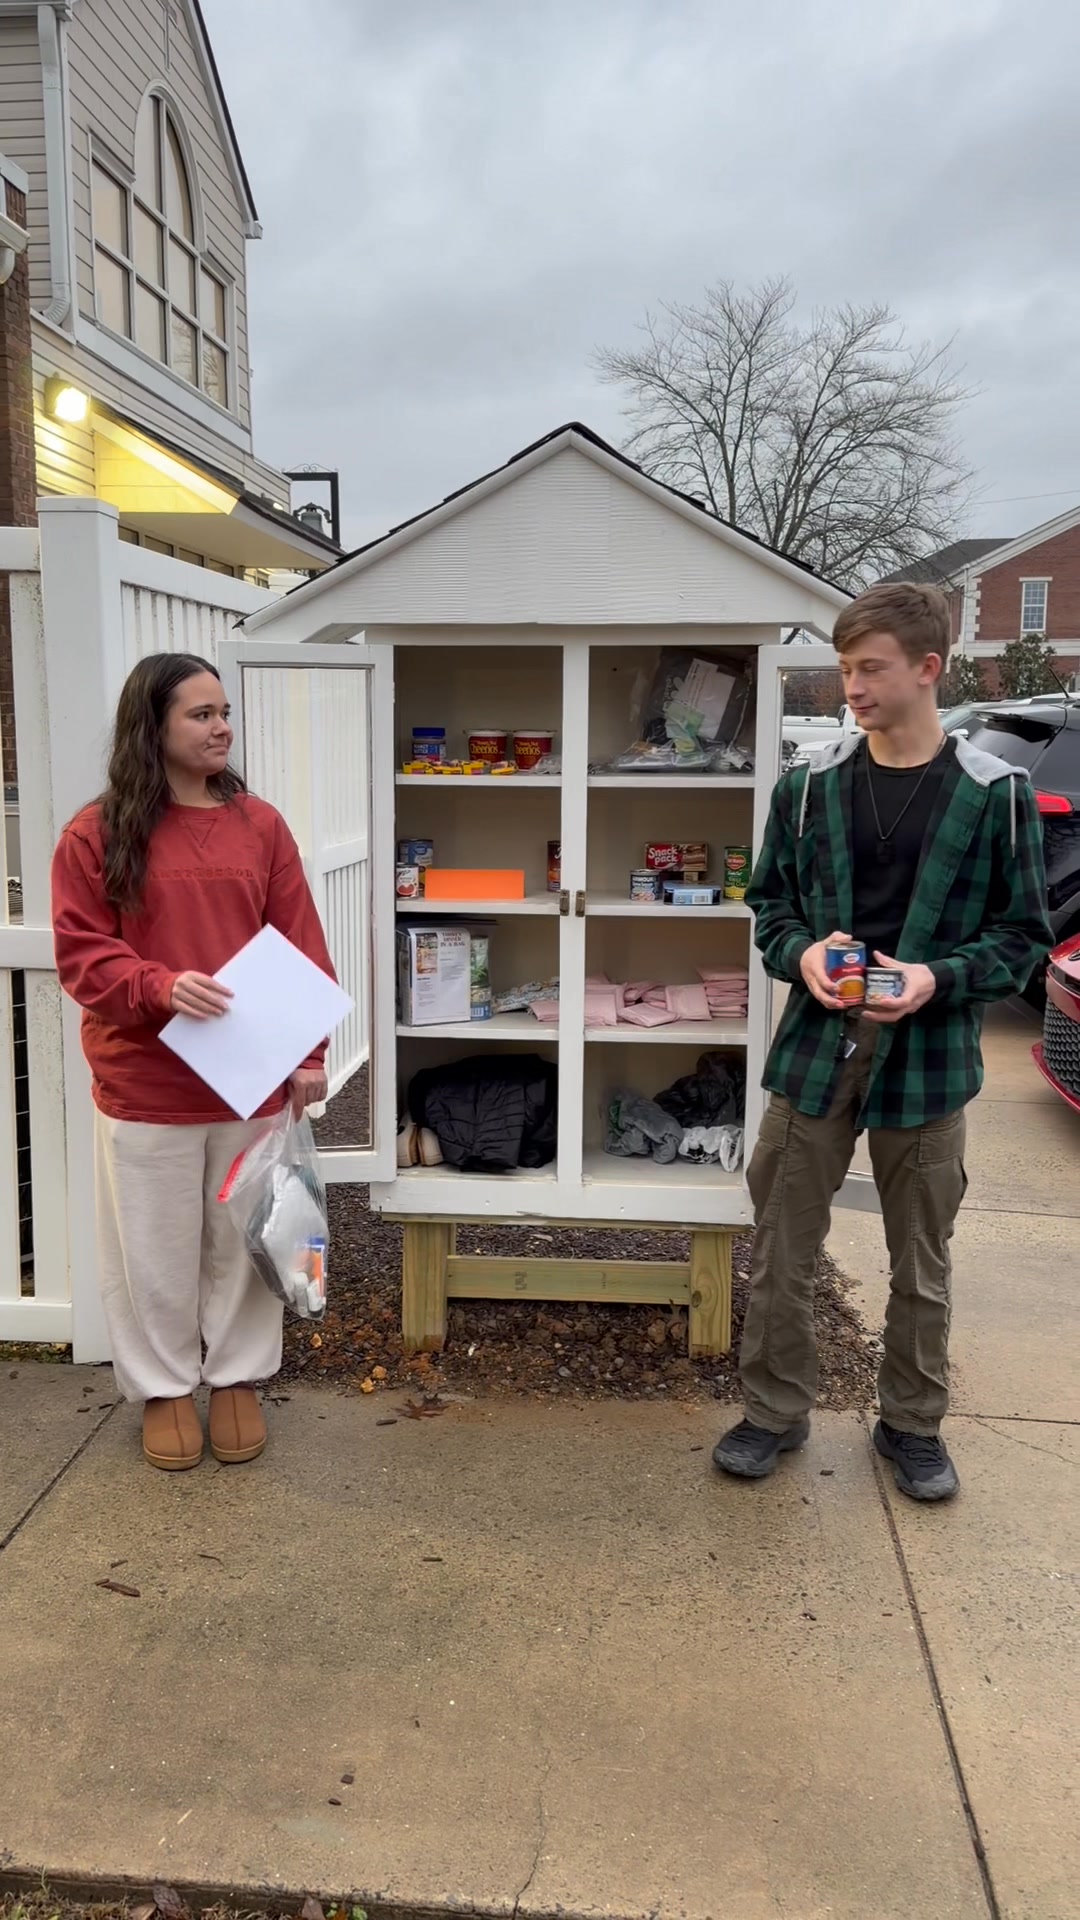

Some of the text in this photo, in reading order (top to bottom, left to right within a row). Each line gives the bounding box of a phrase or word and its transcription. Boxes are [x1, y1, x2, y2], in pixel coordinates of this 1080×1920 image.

[470, 743, 498, 754] Cheerios
[648, 847, 678, 859] Snack
[655, 855, 679, 866] pack
